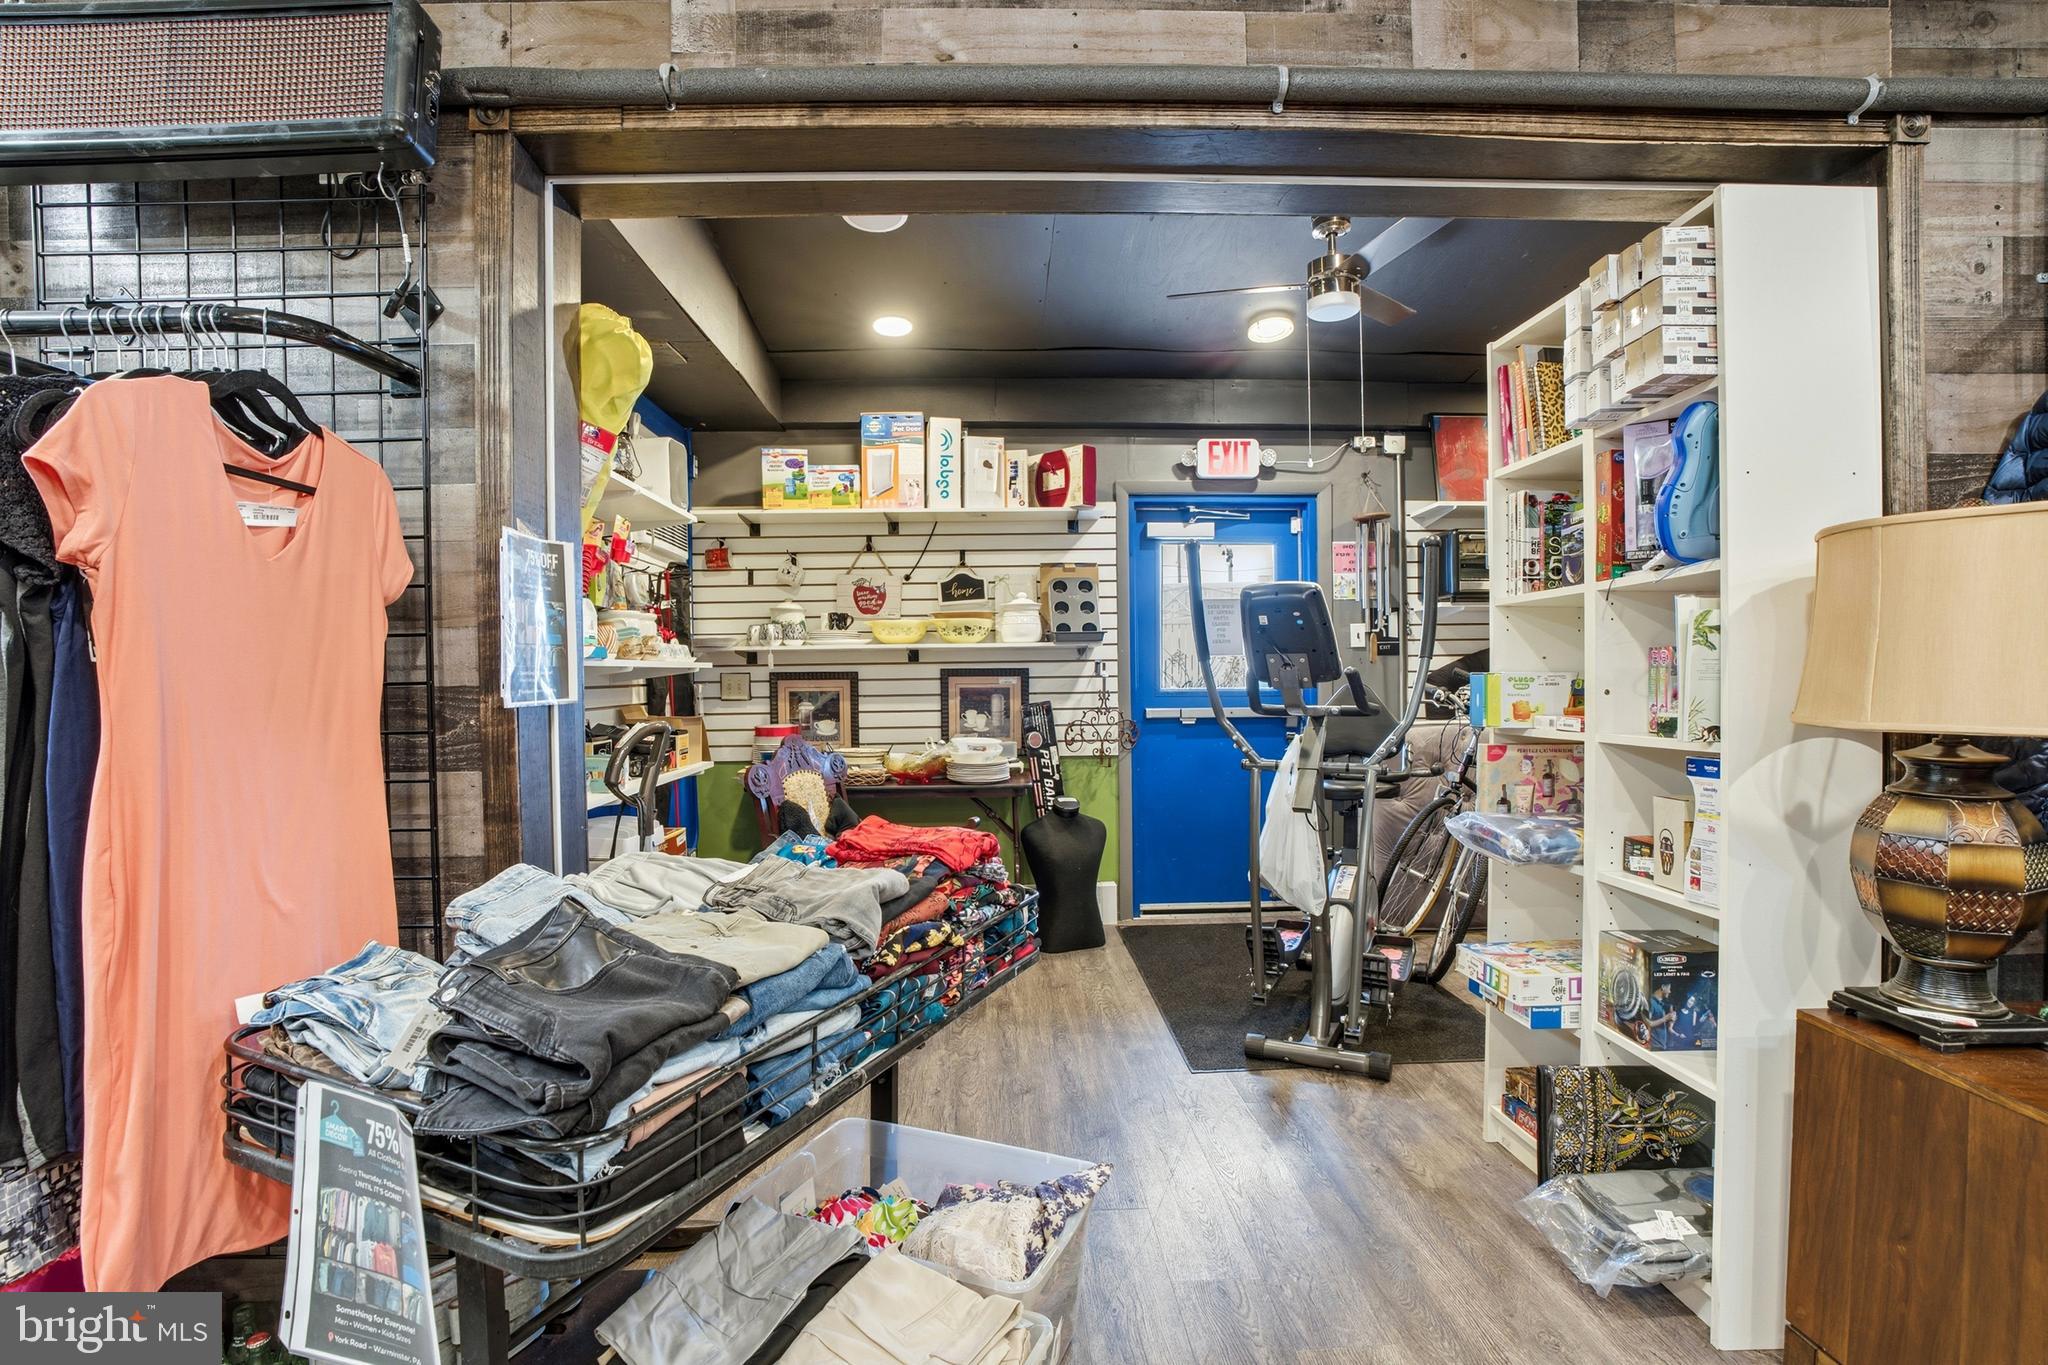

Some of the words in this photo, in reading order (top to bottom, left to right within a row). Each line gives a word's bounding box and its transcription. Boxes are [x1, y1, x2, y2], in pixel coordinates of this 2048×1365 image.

[1208, 441, 1251, 475] EXIT
[946, 583, 981, 598] home
[1040, 750, 1053, 776] PET
[366, 1118, 399, 1154] 75%
[338, 1164, 357, 1177] Starting
[377, 1152, 401, 1169] Clothing
[355, 1180, 373, 1192] UNTIL
[334, 1316, 349, 1327] Men
[352, 1321, 378, 1334] Women
[381, 1328, 396, 1340] Kids
[395, 1333, 412, 1345] Sizes
[335, 1304, 373, 1322] Something
[373, 1314, 384, 1324] for
[384, 1317, 416, 1336] Everyone!
[335, 1335, 349, 1345] York
[349, 1339, 368, 1350] Road
